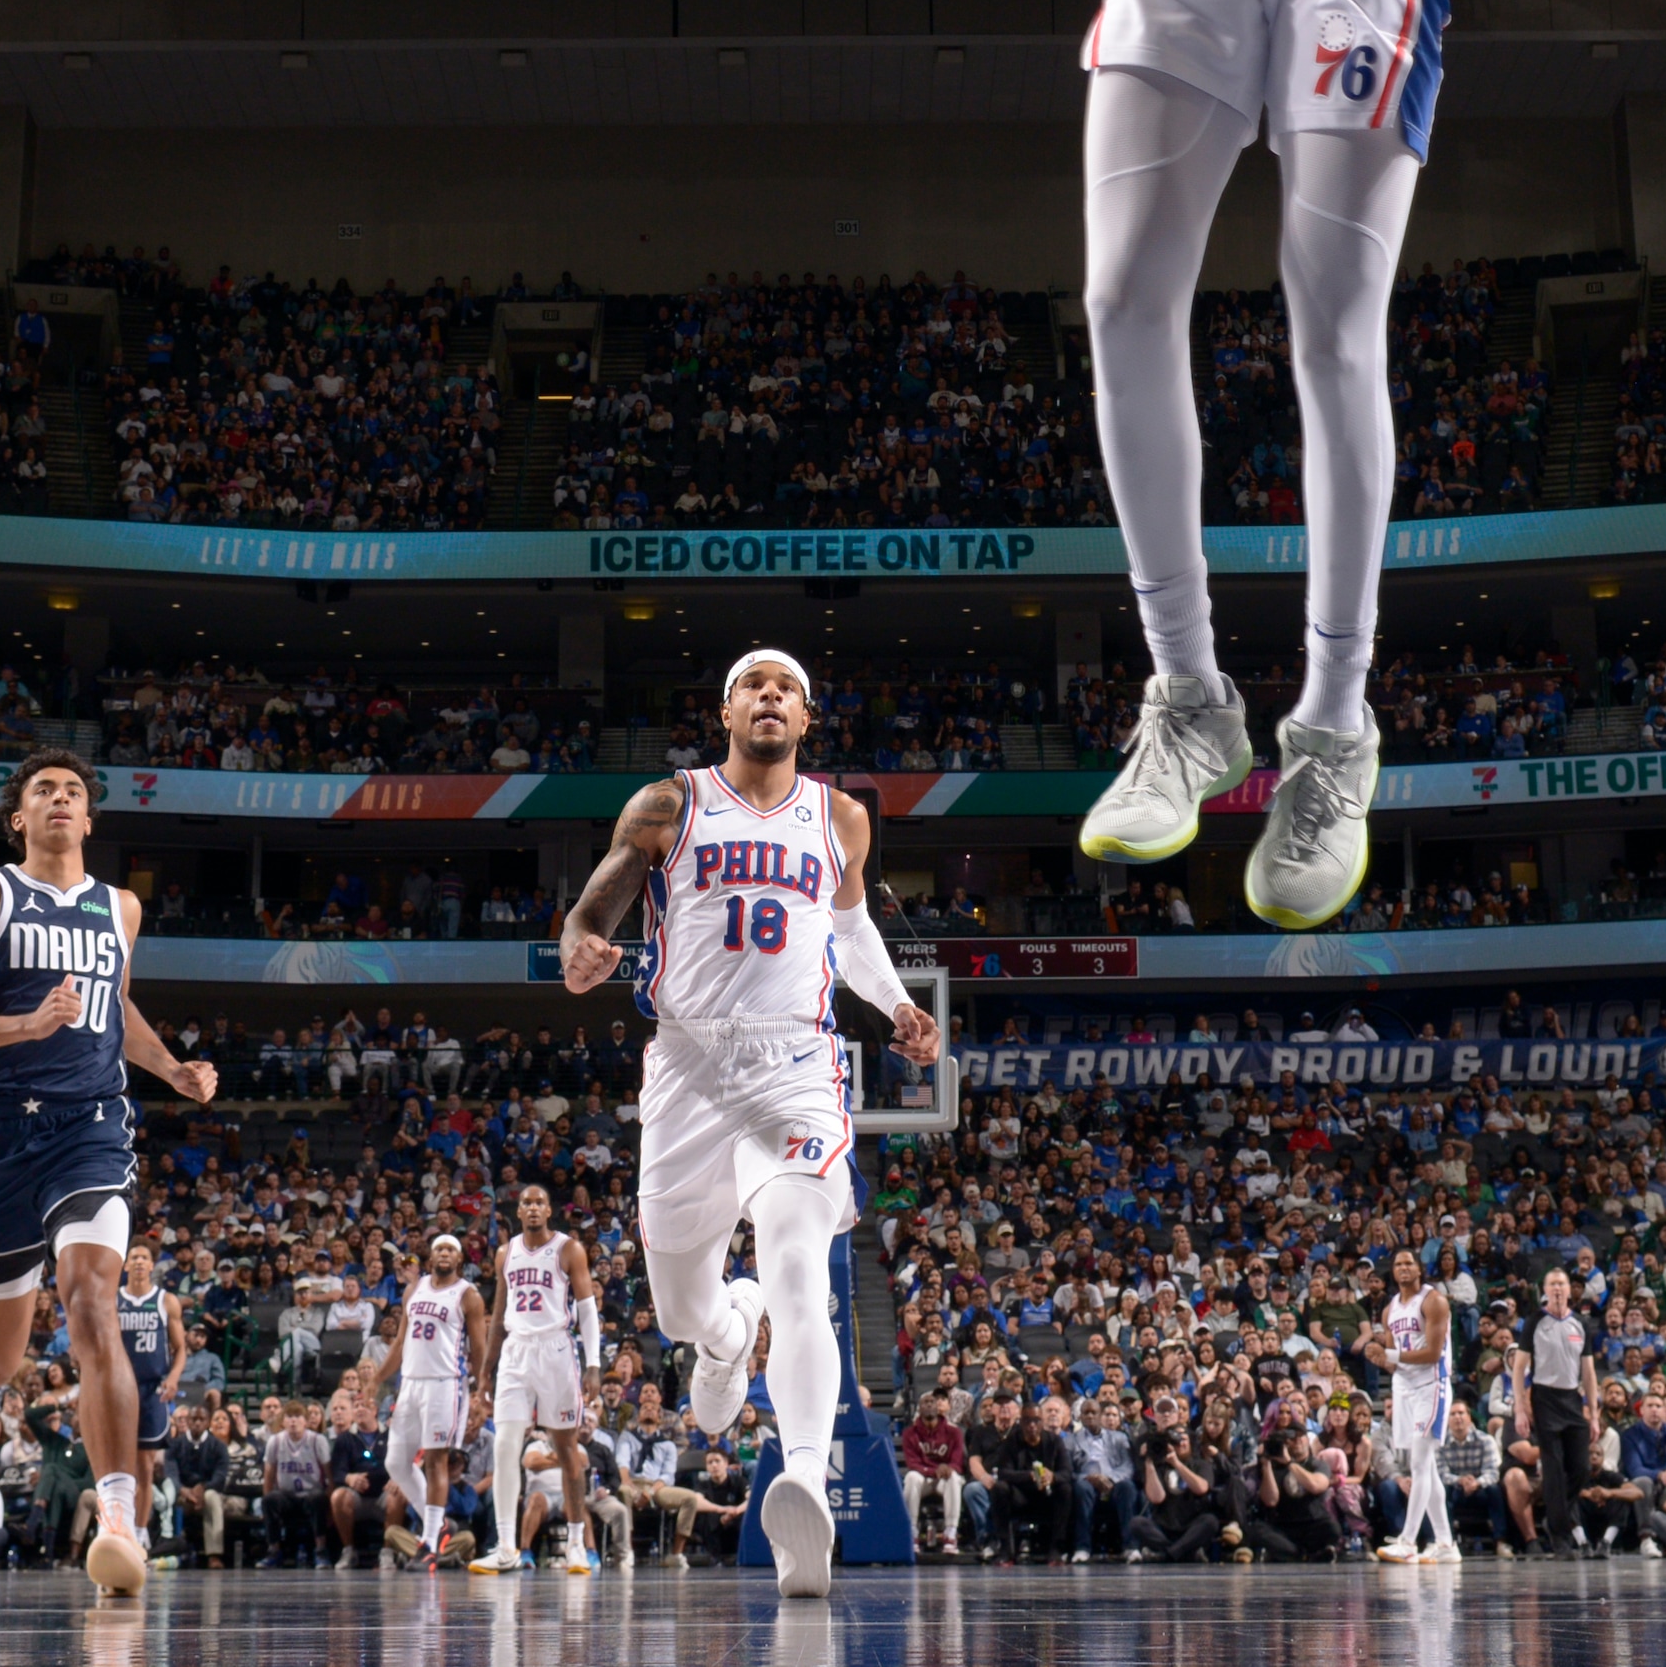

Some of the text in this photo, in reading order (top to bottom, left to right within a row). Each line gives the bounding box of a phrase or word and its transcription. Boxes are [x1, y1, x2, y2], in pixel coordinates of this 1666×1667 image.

[1314, 41, 1377, 101] 76
[590, 534, 1034, 572] ICED COFFEE ON TAP
[1519, 759, 1599, 797] THE
[694, 840, 823, 904] PHILA
[81, 901, 109, 916] chime
[723, 895, 788, 955] 18
[10, 922, 115, 977] MAVS
[896, 943, 1128, 955] 76ERS FOULS TIMEOUTS
[1033, 958, 1104, 974] 3 3
[960, 1049, 1051, 1086] GET
[1270, 1047, 1434, 1083] PROUD
[1451, 1046, 1482, 1082] &
[1499, 1044, 1642, 1082] LOUD!
[784, 1135, 823, 1161] 76
[508, 1268, 553, 1289] PHILA
[409, 1302, 449, 1322] PHILA
[516, 1290, 542, 1312] 22
[135, 1331, 157, 1352] 20
[412, 1321, 436, 1340] 28
